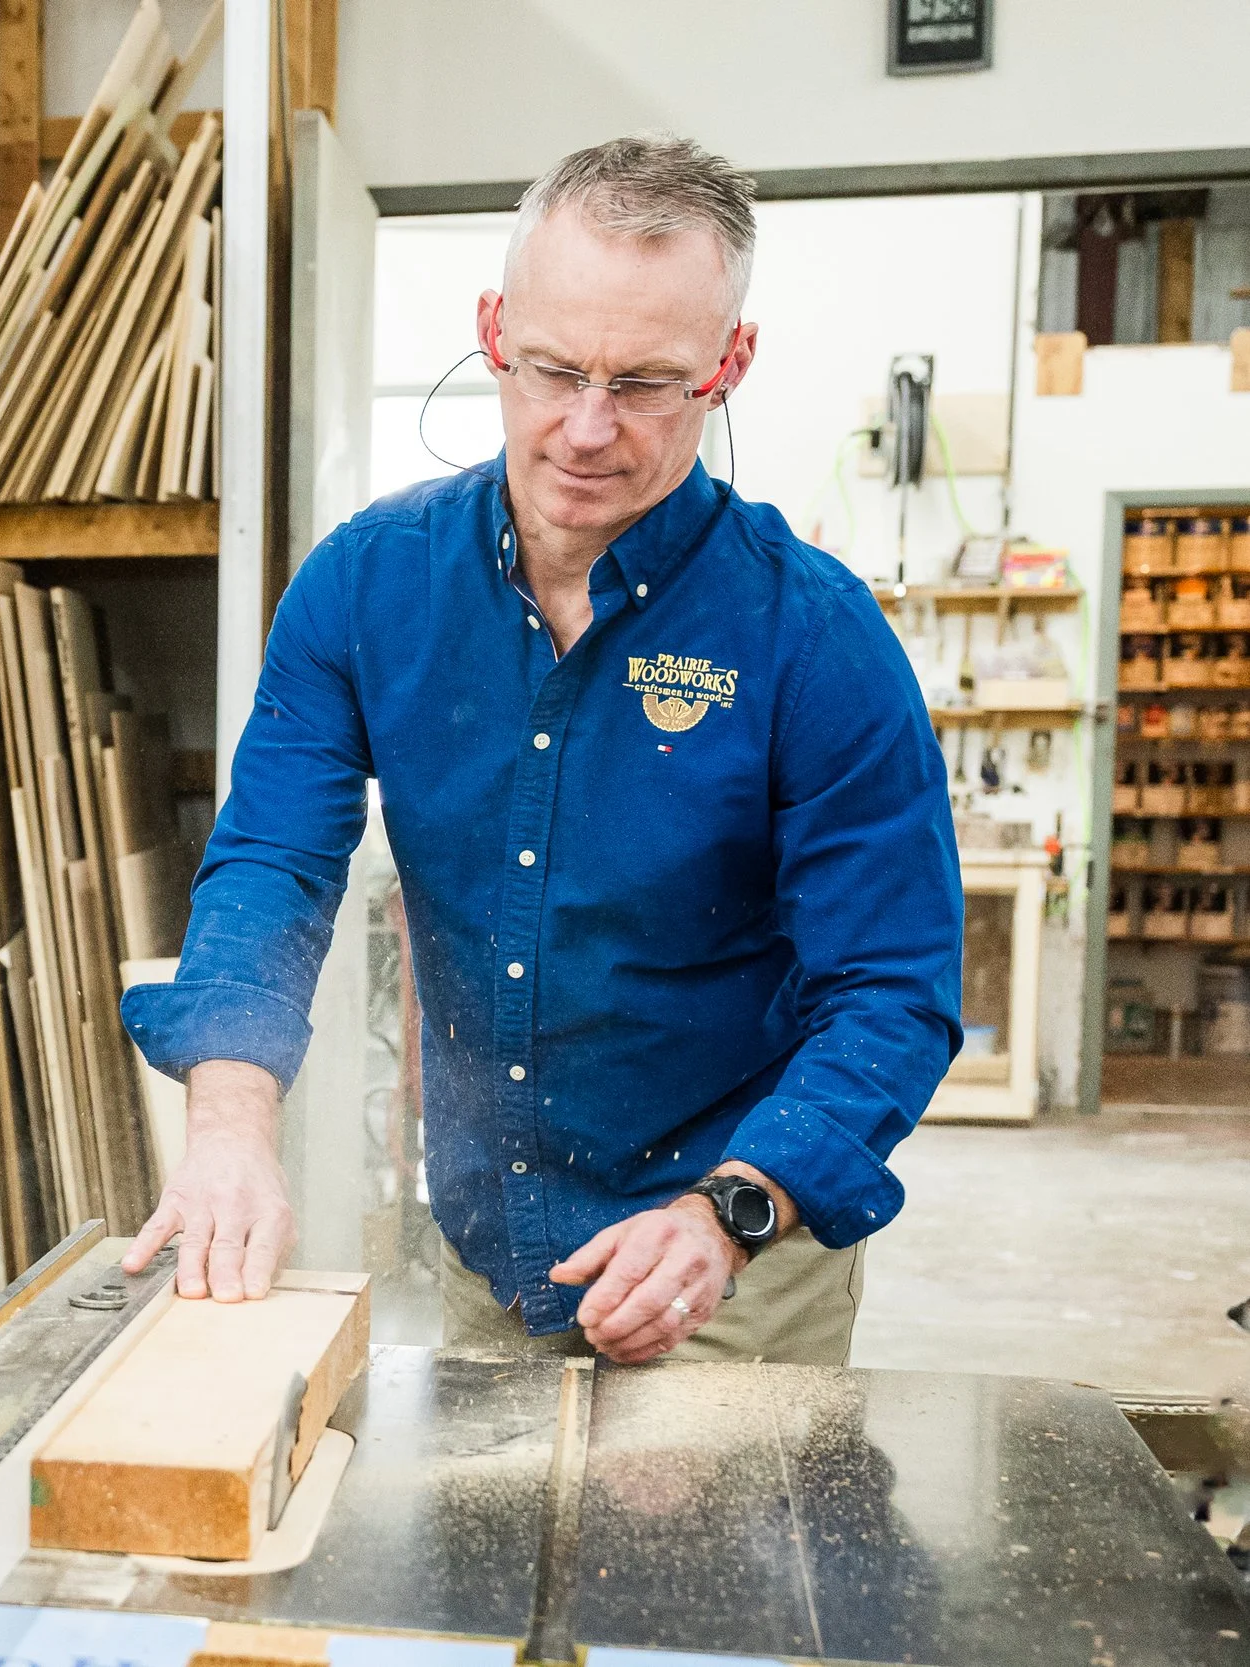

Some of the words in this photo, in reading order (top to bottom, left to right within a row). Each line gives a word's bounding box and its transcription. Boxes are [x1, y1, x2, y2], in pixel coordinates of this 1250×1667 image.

[656, 653, 712, 672] PRAIRIE
[628, 656, 738, 695] WOODWORKS
[634, 683, 683, 697] craftsmen
[684, 688, 694, 698] in
[696, 692, 722, 702] wood
